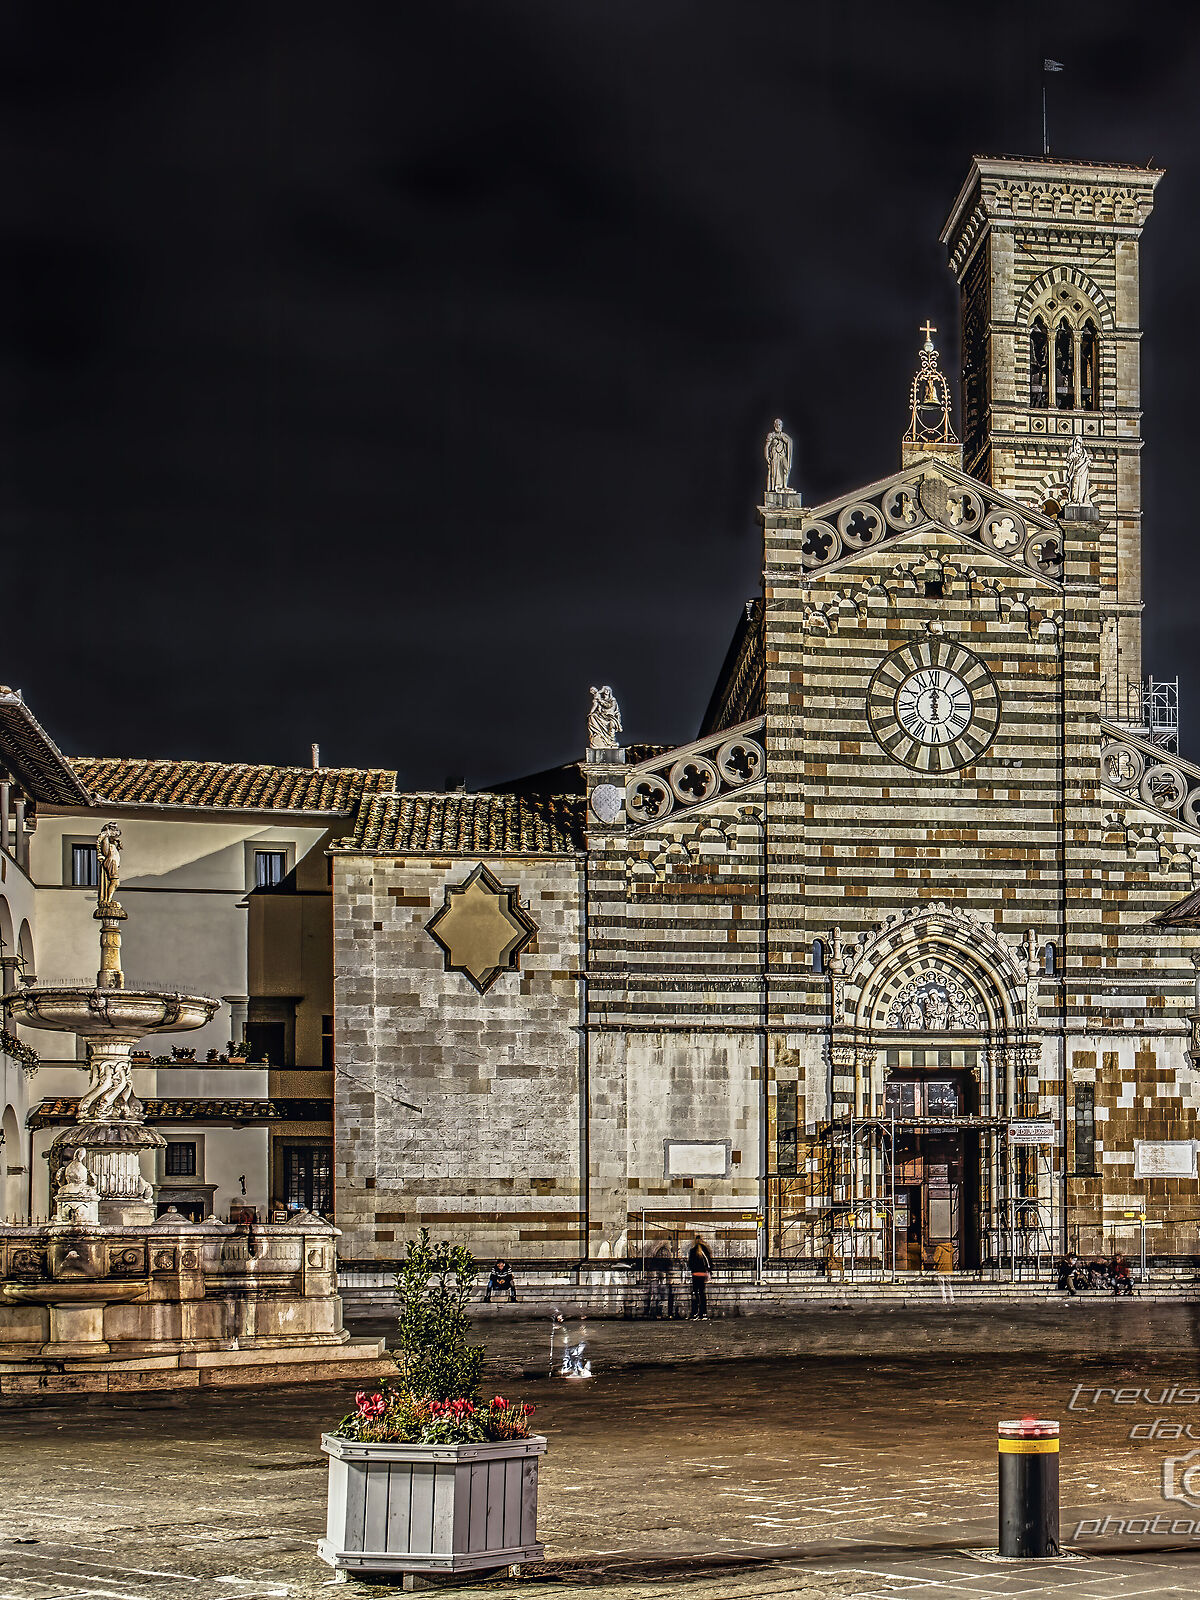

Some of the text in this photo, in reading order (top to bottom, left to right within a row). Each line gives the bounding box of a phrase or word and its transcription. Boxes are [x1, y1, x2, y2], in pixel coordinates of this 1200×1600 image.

[928, 670, 940, 687] XII
[951, 687, 967, 698] II
[954, 702, 970, 712] III
[950, 712, 968, 729] IIII
